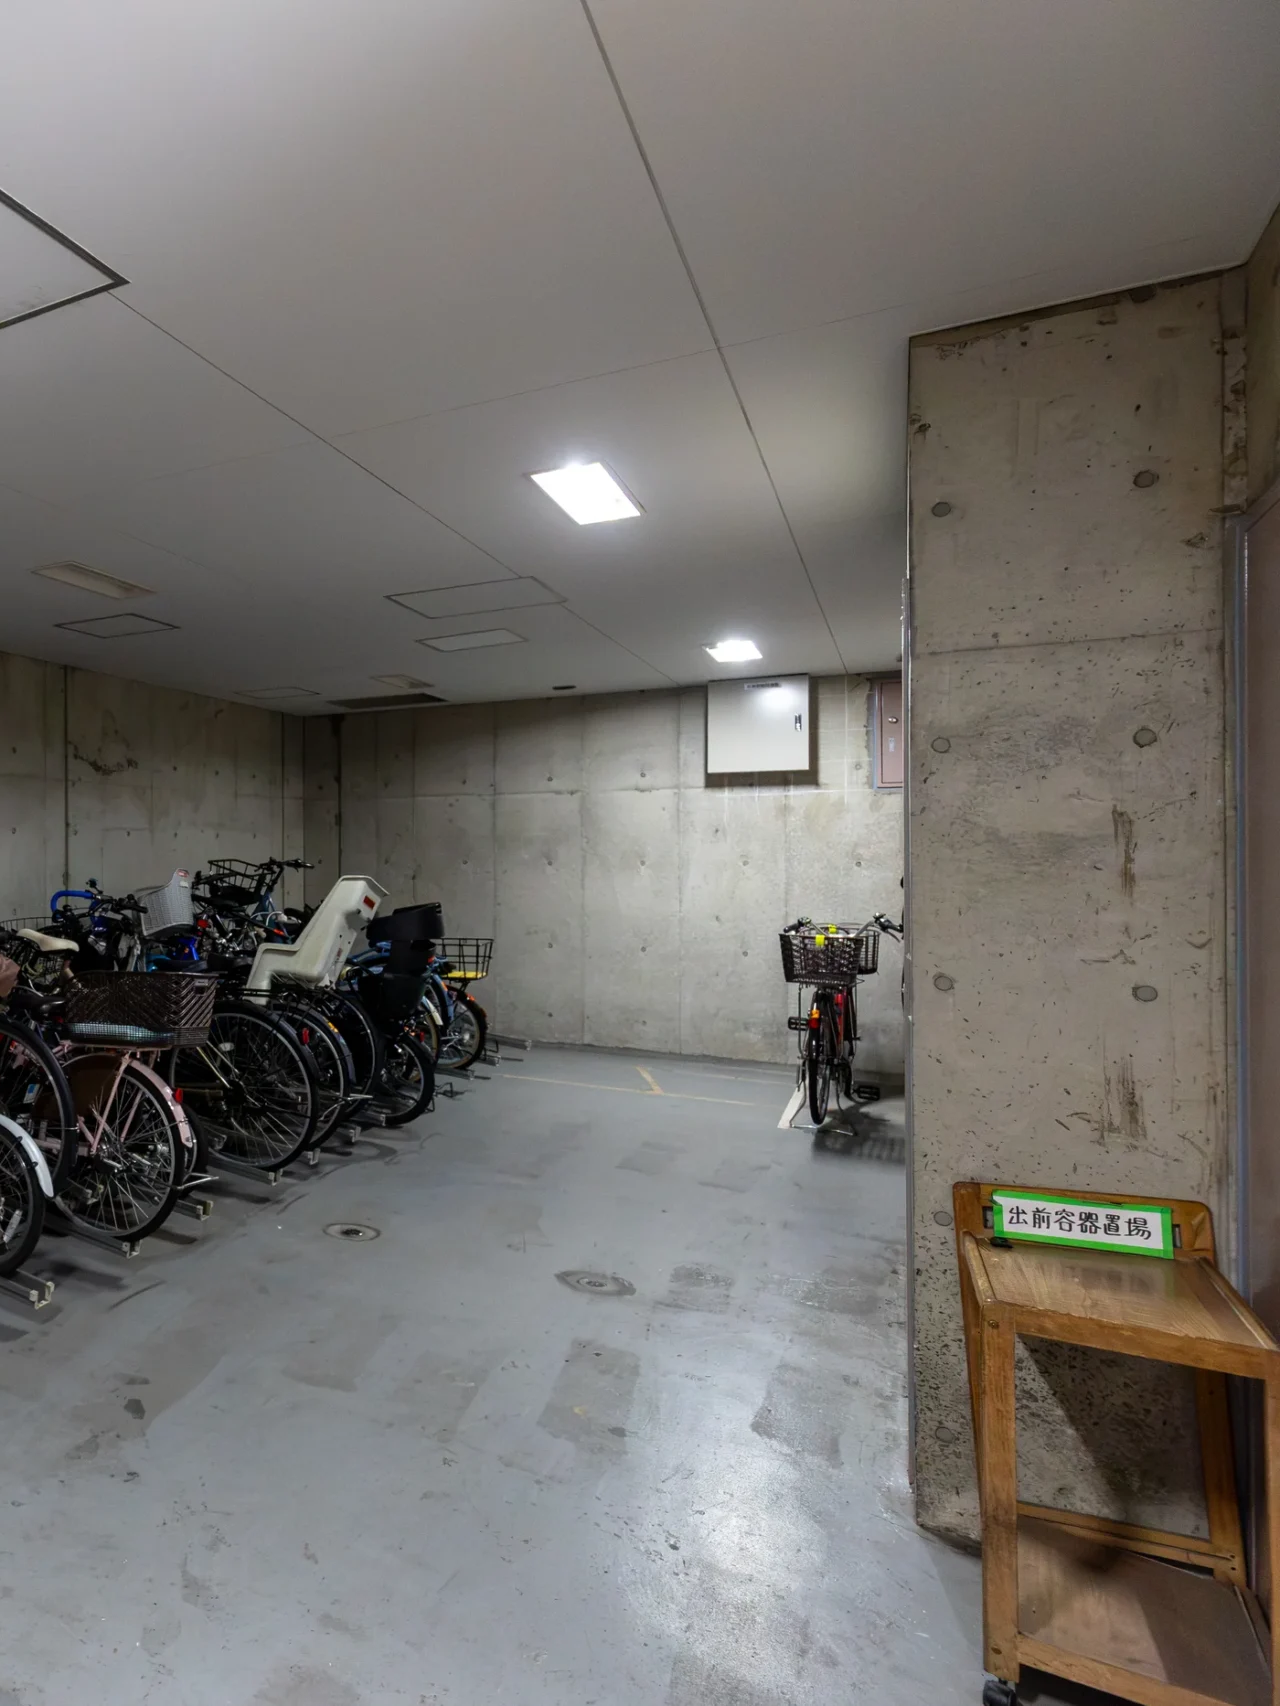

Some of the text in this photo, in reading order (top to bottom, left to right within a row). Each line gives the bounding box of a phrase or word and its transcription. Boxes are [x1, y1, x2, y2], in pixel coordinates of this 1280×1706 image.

[1008, 1205, 1152, 1240] 出前容器置場
